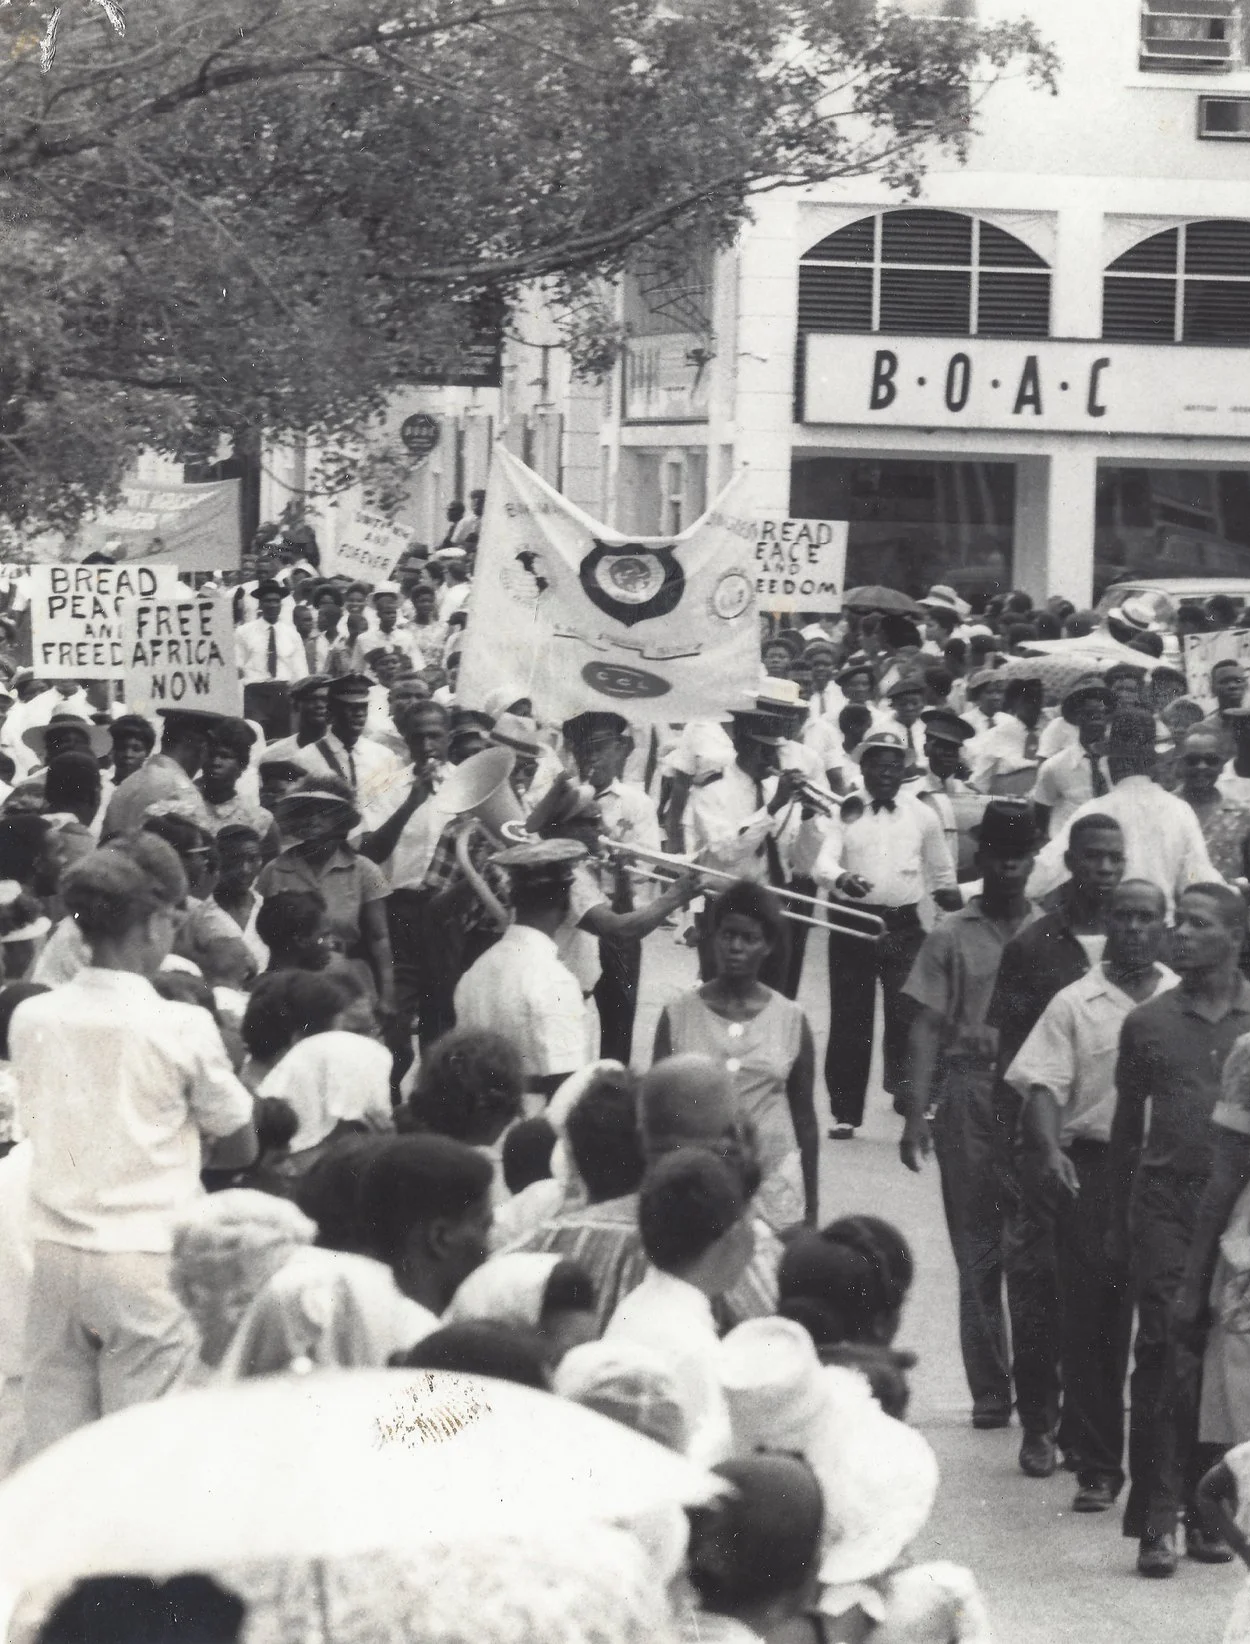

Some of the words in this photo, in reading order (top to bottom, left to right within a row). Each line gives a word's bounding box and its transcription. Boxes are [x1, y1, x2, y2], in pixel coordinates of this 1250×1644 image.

[761, 520, 833, 545] READ
[755, 542, 821, 564] EACE
[762, 561, 801, 575] AND
[50, 567, 158, 597] BREAD
[755, 578, 838, 596] EEDOM
[48, 596, 156, 619] PEAC
[84, 623, 124, 640] AN
[136, 601, 215, 639] FREE
[41, 642, 125, 666] FREED
[131, 638, 226, 669] AFRICA
[151, 671, 211, 701] NOW
